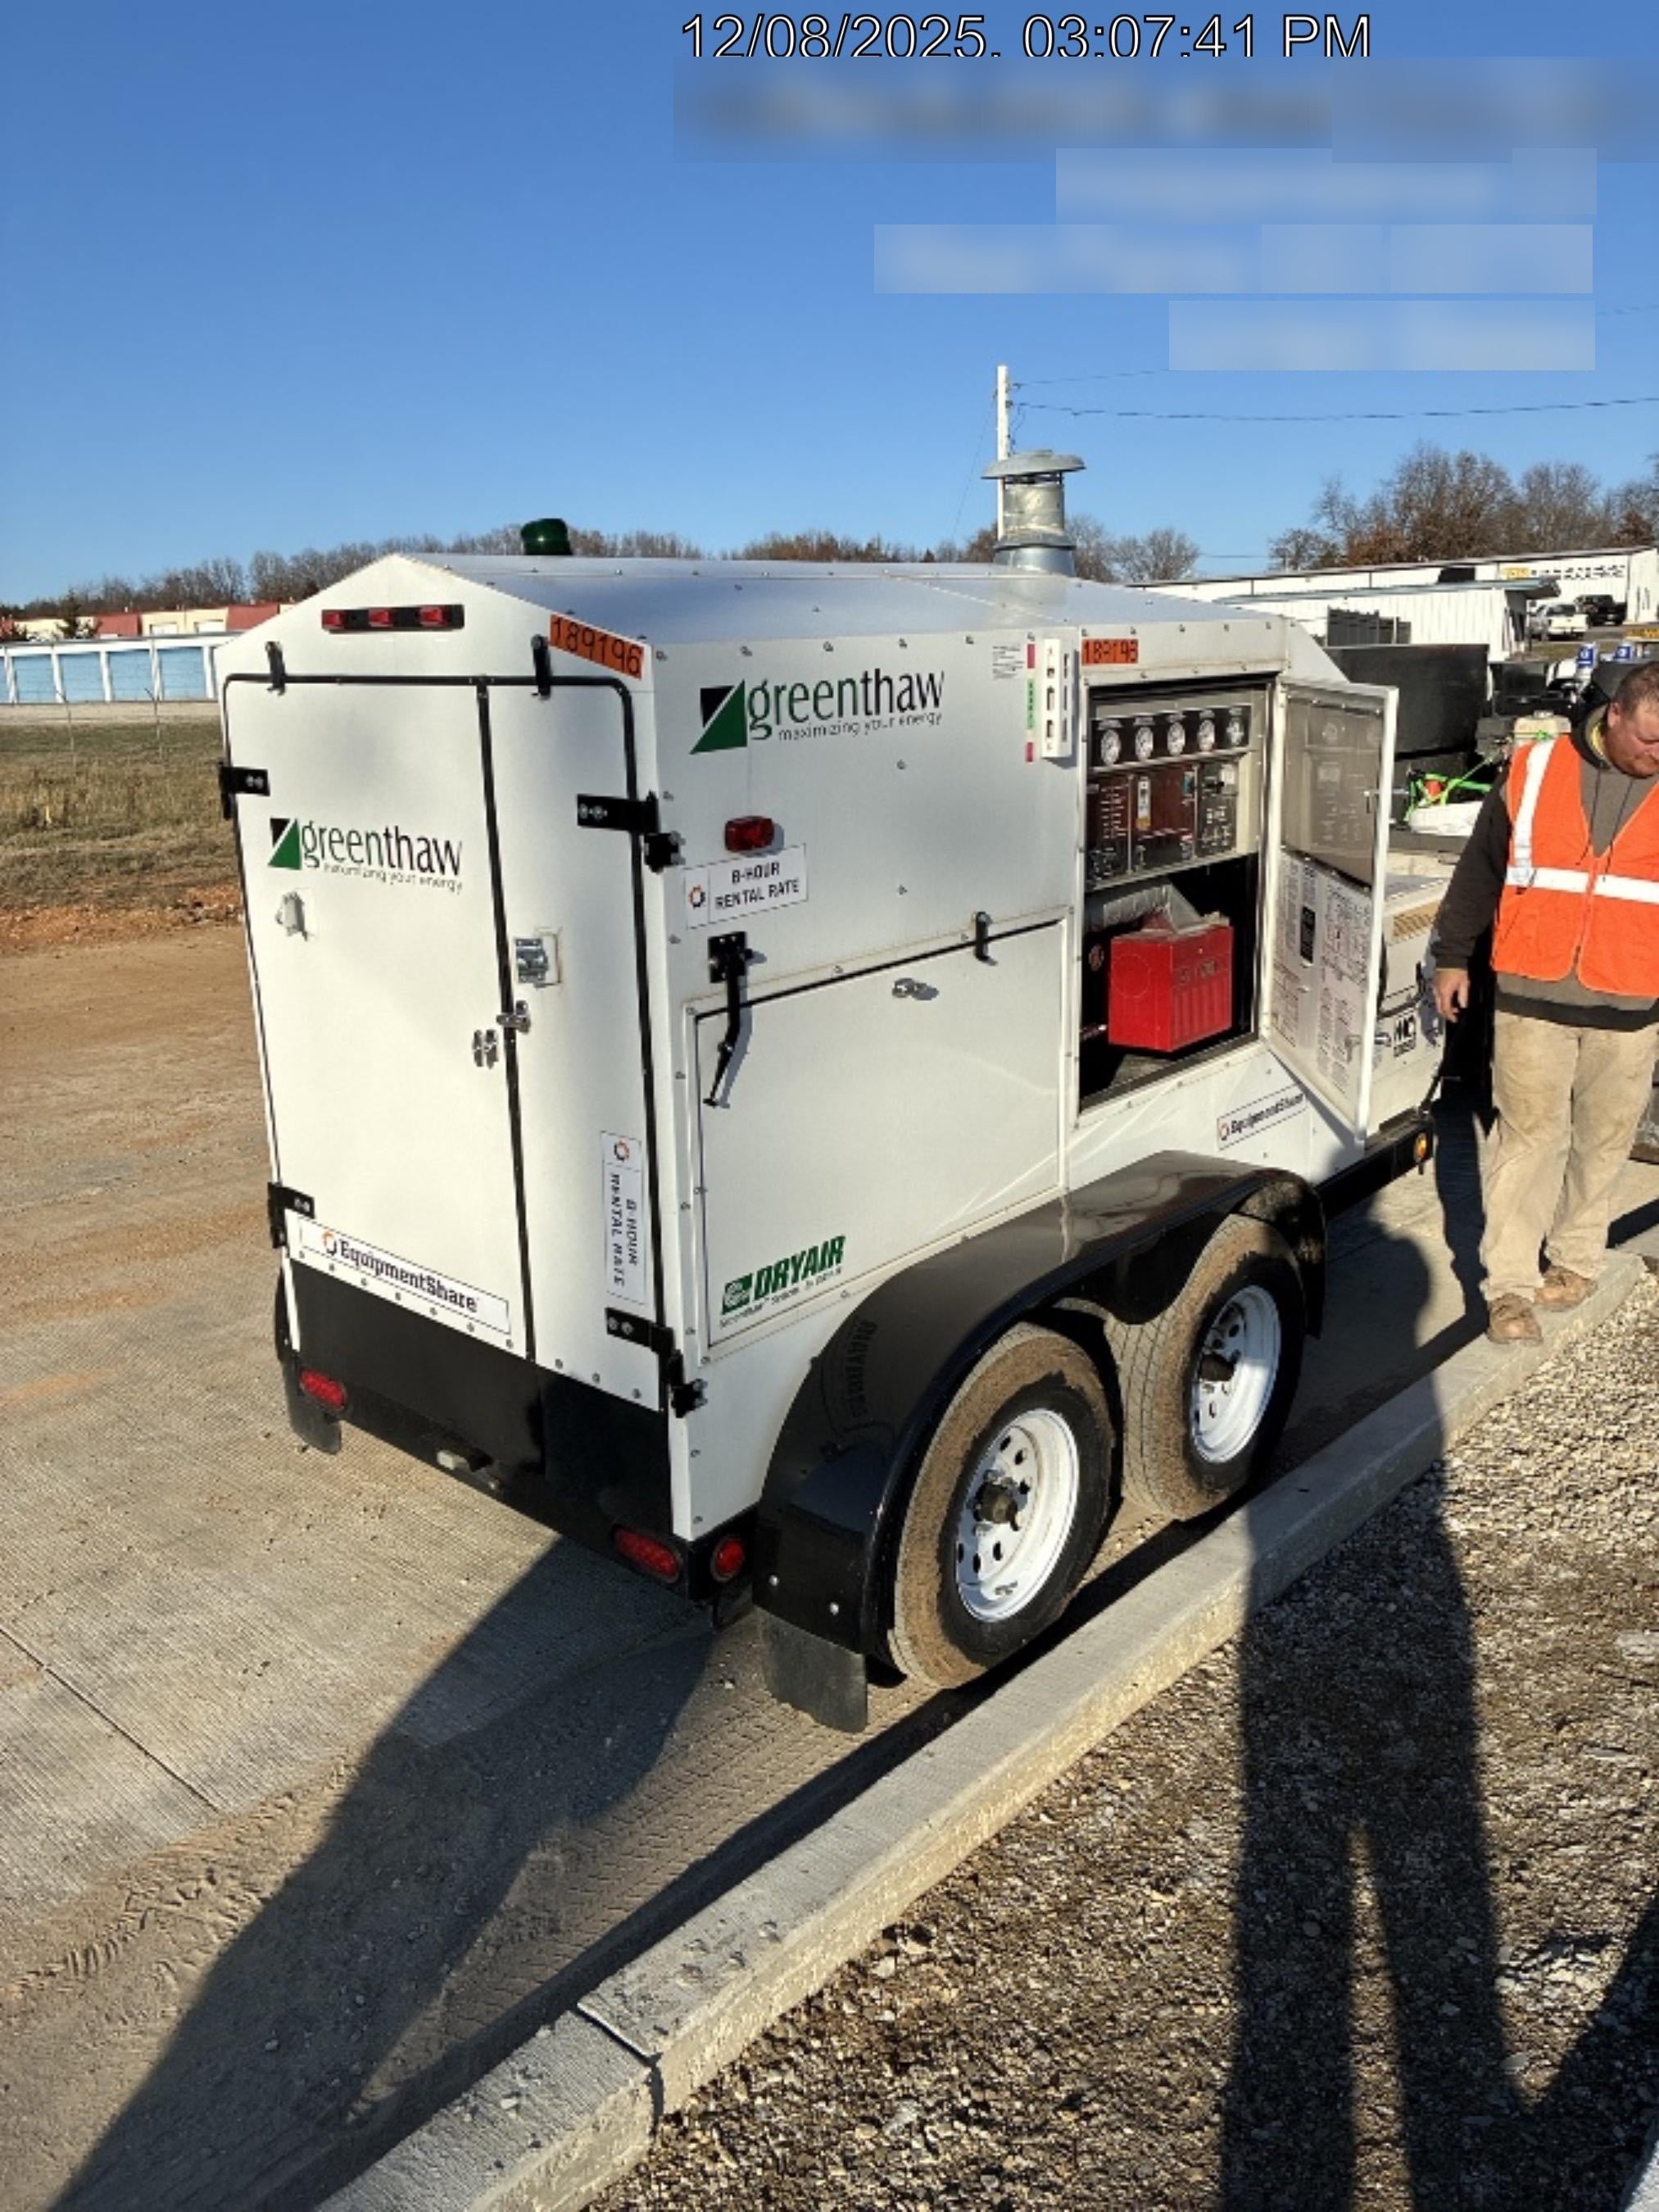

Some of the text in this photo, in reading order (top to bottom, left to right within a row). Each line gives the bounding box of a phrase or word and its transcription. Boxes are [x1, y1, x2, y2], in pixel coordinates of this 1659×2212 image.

[551, 616, 644, 677] 189196
[748, 669, 944, 740] greenthaw
[779, 721, 859, 741] maximizing
[301, 820, 462, 876] greenthaw
[715, 878, 800, 909] RENTAL RATE
[338, 1239, 479, 1313] EquipmentShare
[755, 1235, 845, 1300] DRYAIR
